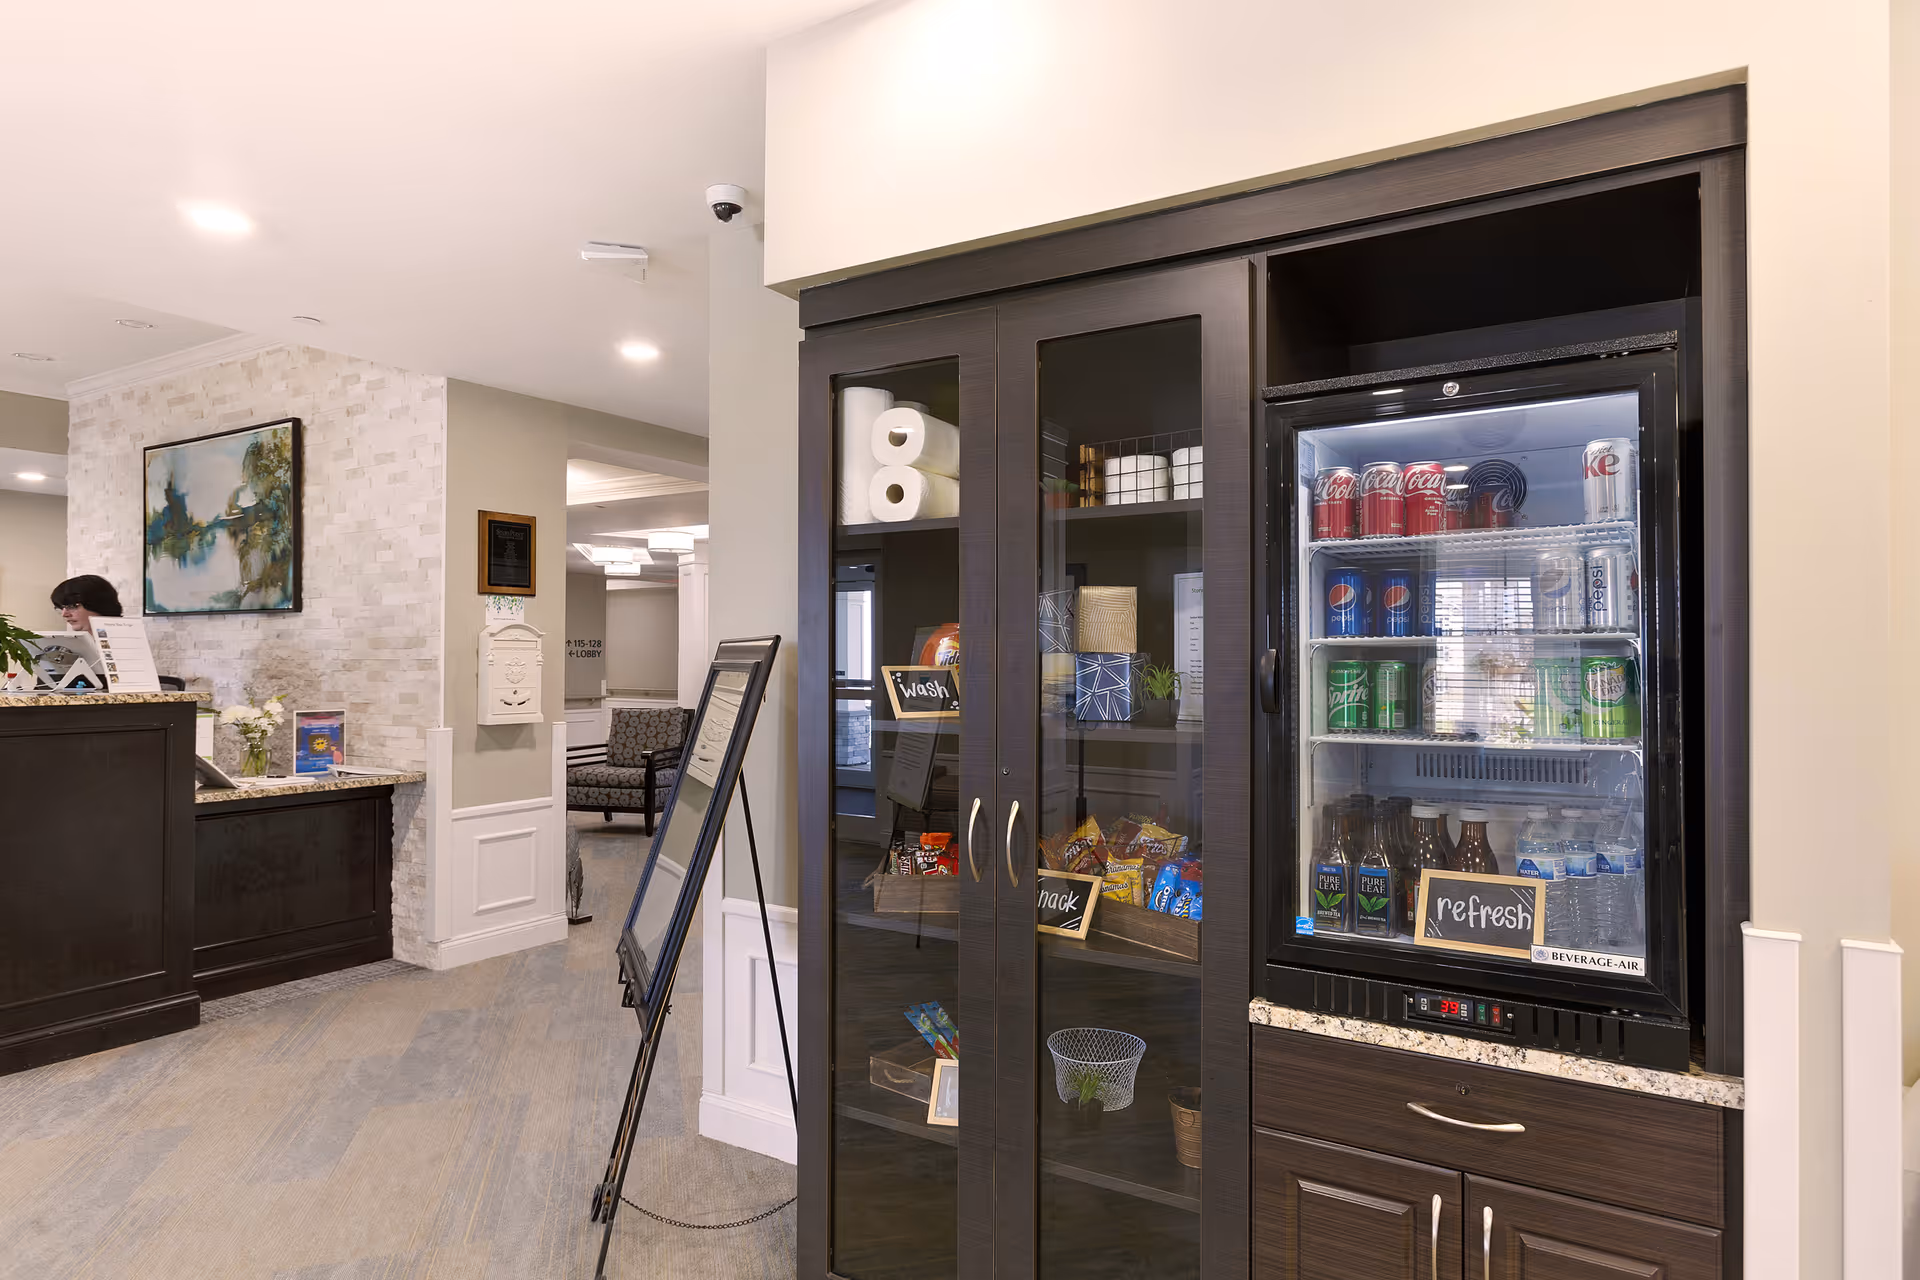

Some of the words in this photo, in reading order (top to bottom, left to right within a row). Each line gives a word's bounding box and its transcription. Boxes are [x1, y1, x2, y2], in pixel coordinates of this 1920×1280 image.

[1592, 565, 1607, 612] pepsi
[1331, 614, 1354, 623] pepsi
[1387, 615, 1410, 623] pepsi
[574, 639, 602, 648] 115-128
[576, 650, 602, 658] LOBBY
[899, 680, 950, 698] wash
[1601, 683, 1623, 697] DRY
[1328, 684, 1369, 709] Sprite
[1320, 875, 1340, 884] PURE
[1361, 876, 1385, 886] PURE
[1319, 882, 1339, 891] LEAF
[1361, 884, 1385, 894] LEAF
[1038, 889, 1080, 913] nack
[1437, 895, 1533, 930] refresh
[1551, 951, 1639, 971] BEVERAGE-AIR
[1441, 1000, 1459, 1014] 39
